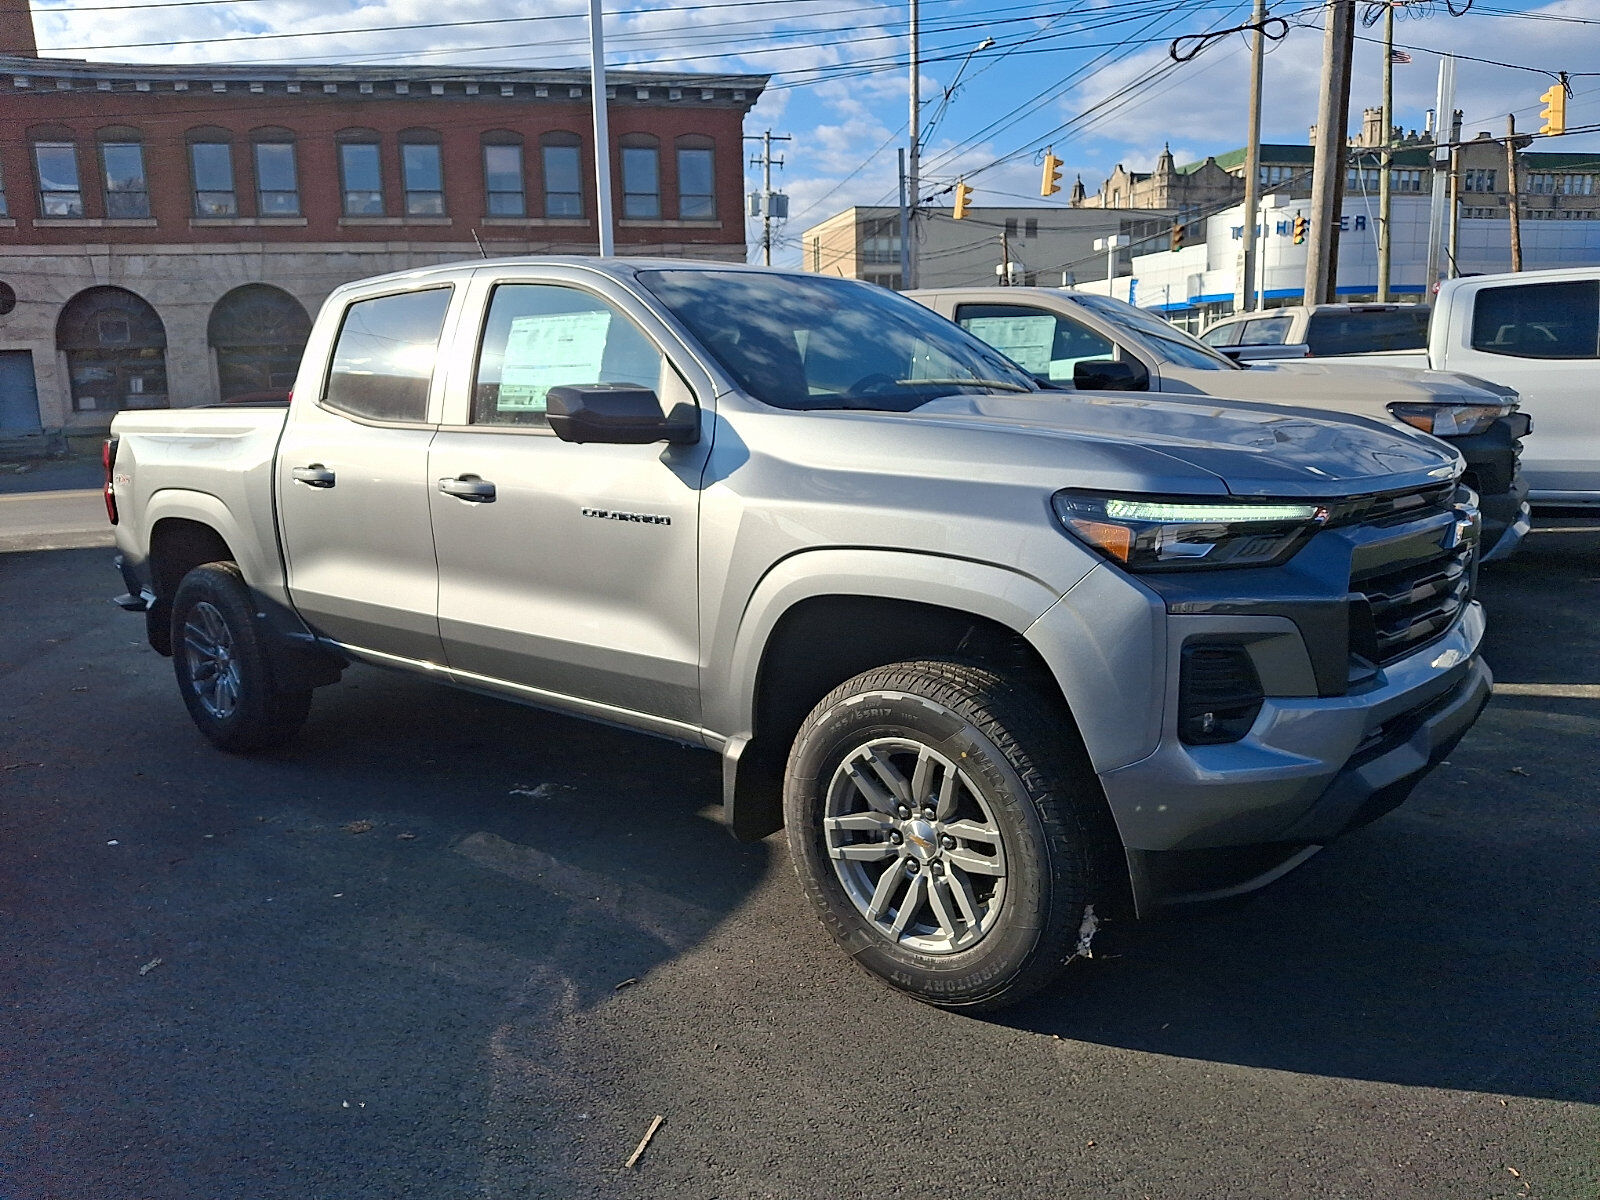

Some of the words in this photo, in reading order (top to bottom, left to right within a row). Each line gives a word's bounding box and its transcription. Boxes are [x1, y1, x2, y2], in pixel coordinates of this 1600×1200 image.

[1276, 215, 1367, 235] HER
[582, 507, 671, 526] COLORADO
[924, 960, 1008, 992] TERRITORY
